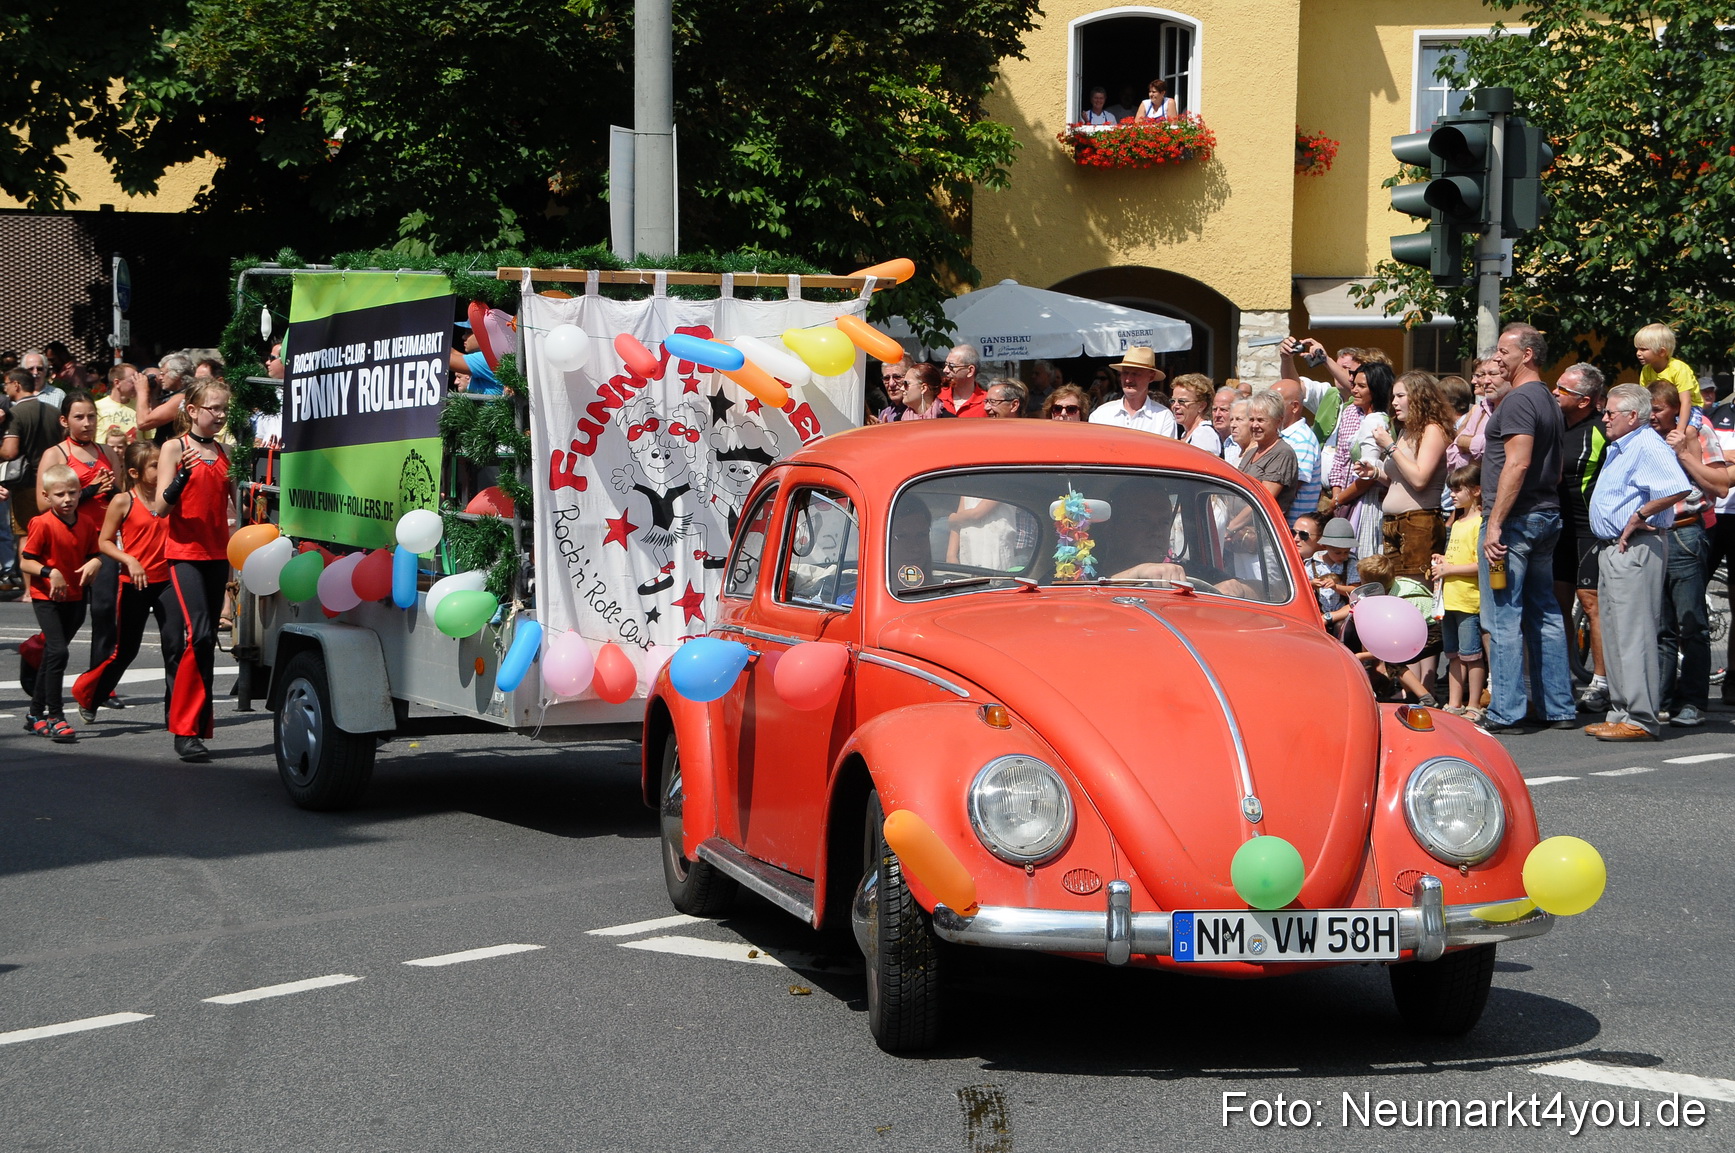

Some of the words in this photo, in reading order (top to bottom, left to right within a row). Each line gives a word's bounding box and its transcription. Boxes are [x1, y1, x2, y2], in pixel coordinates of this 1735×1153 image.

[373, 339, 391, 361] DJK
[391, 331, 444, 358] NEUMARKT
[291, 370, 353, 423] FUNNY
[358, 358, 443, 414] ROLLERS
[288, 488, 394, 522] WWW.FUNNY-ROLLERS.DE
[1197, 917, 1245, 956] NM
[1271, 916, 1318, 954] VW
[1327, 915, 1396, 954] 58H
